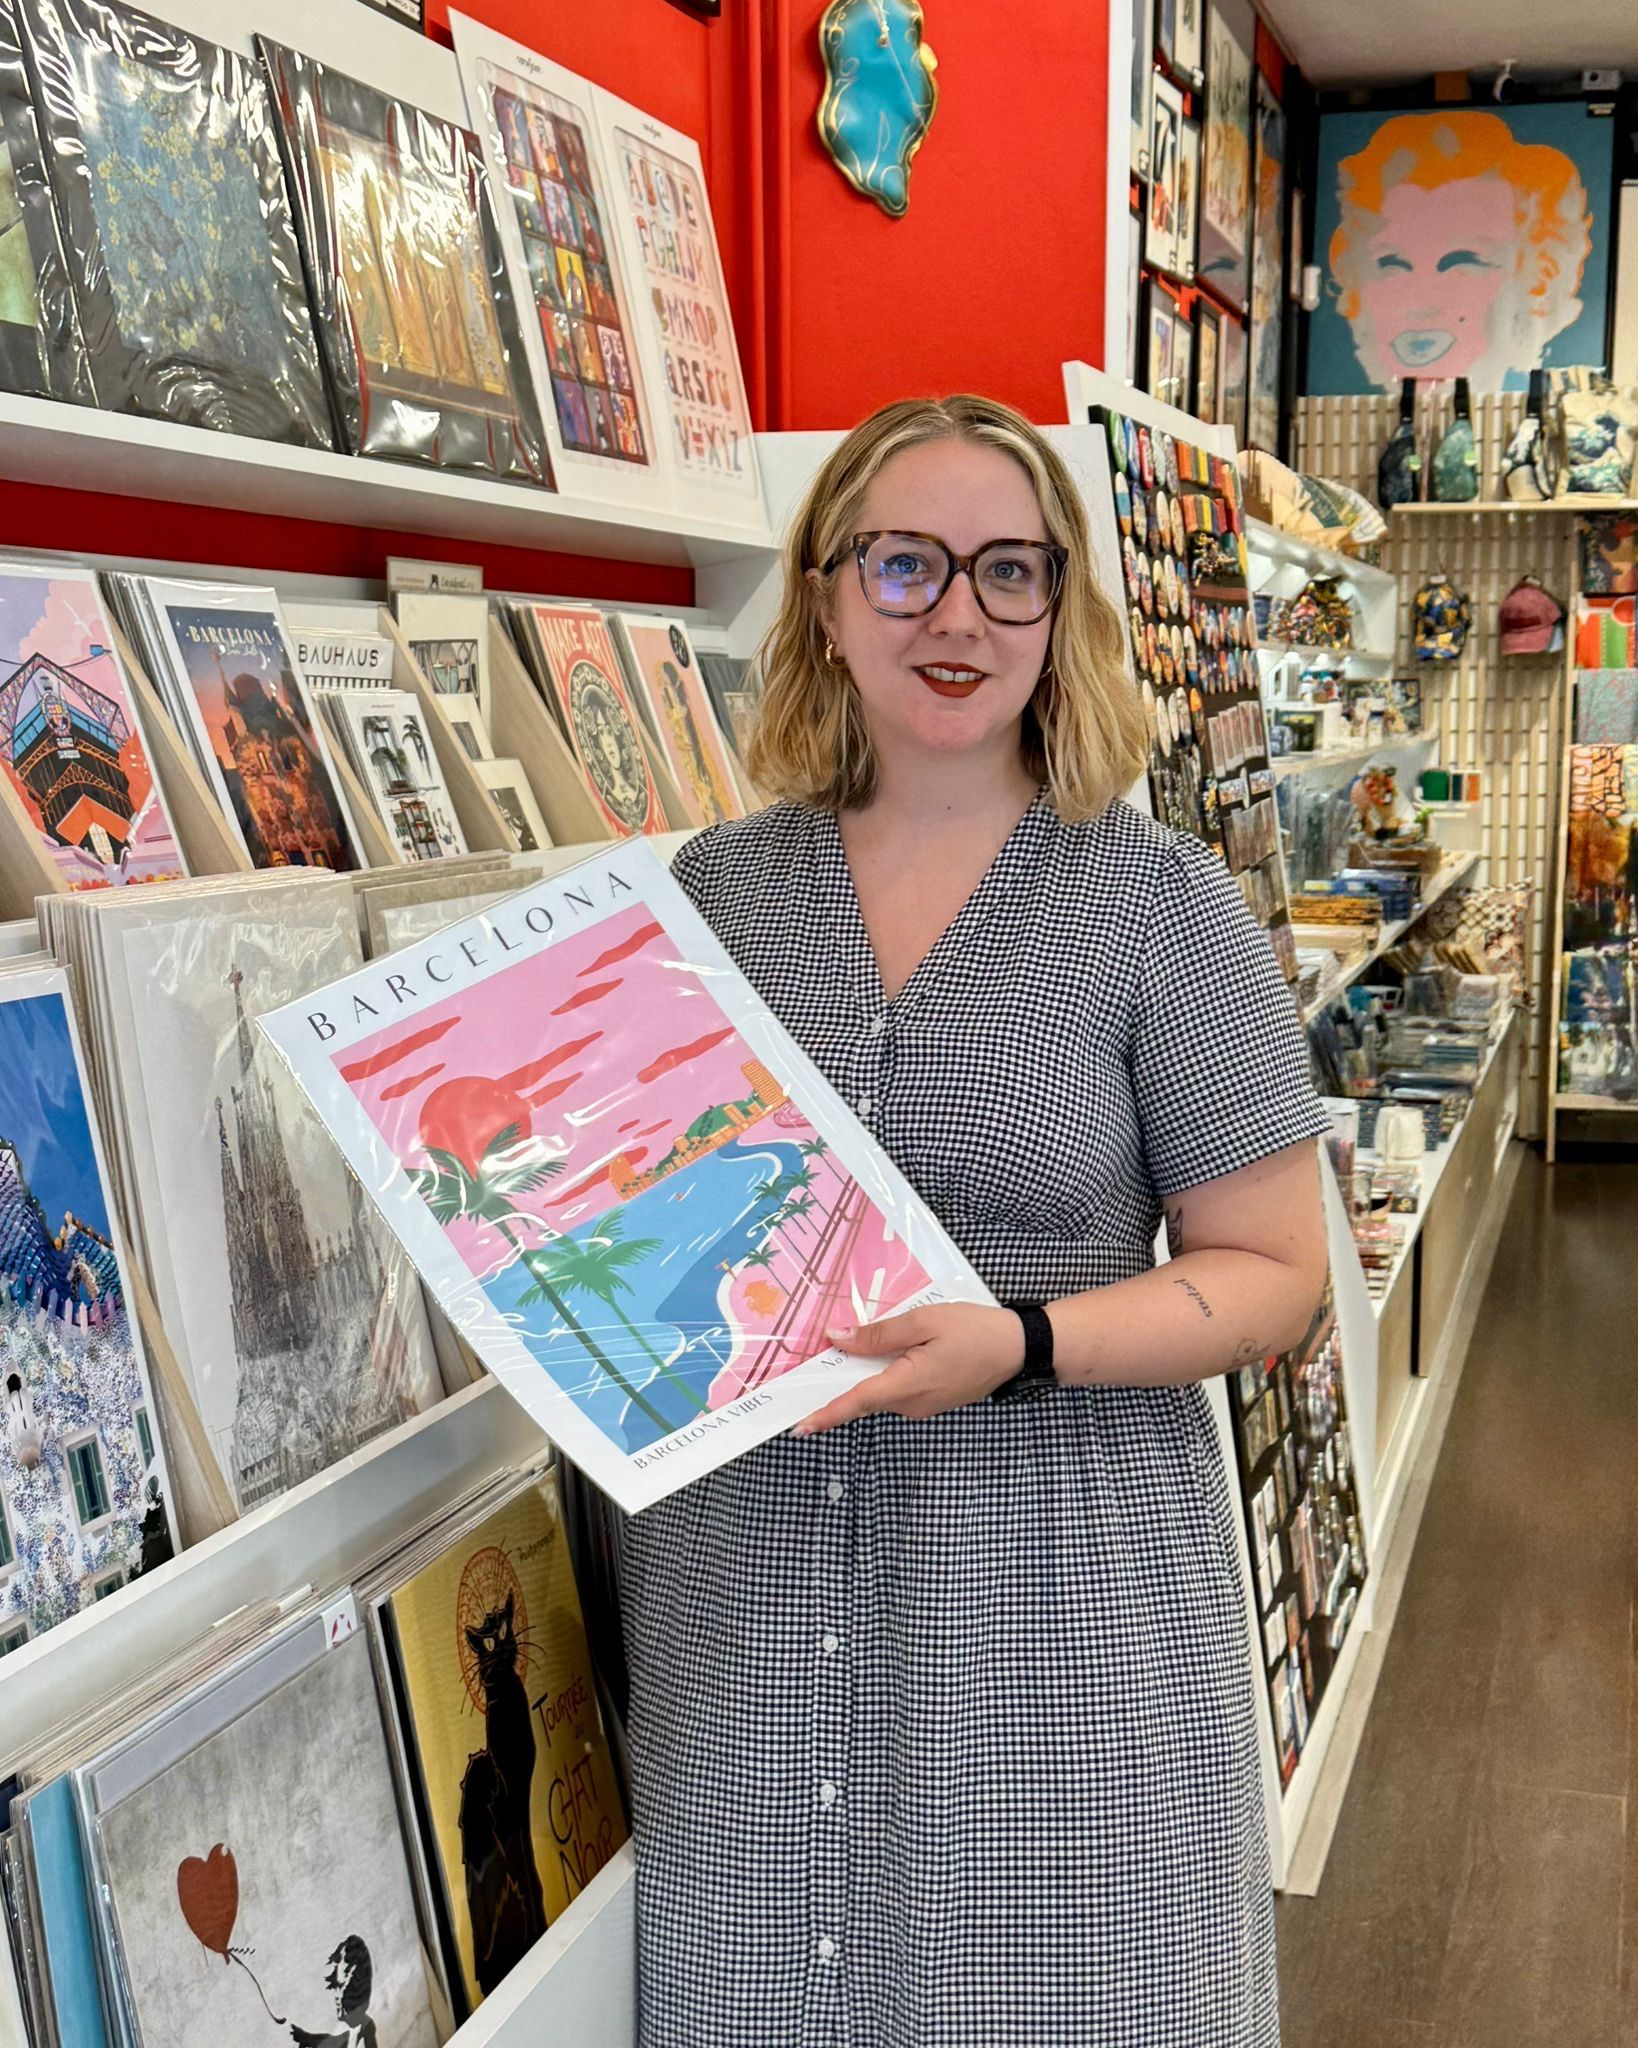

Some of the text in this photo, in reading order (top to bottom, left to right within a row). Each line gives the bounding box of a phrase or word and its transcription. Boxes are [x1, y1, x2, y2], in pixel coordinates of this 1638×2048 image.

[298, 643, 380, 668] BAUHAUS
[307, 871, 633, 1041] BARCELONA
[633, 1392, 774, 1469] BARCELONA VIBES
[548, 1754, 598, 1850] CHAT
